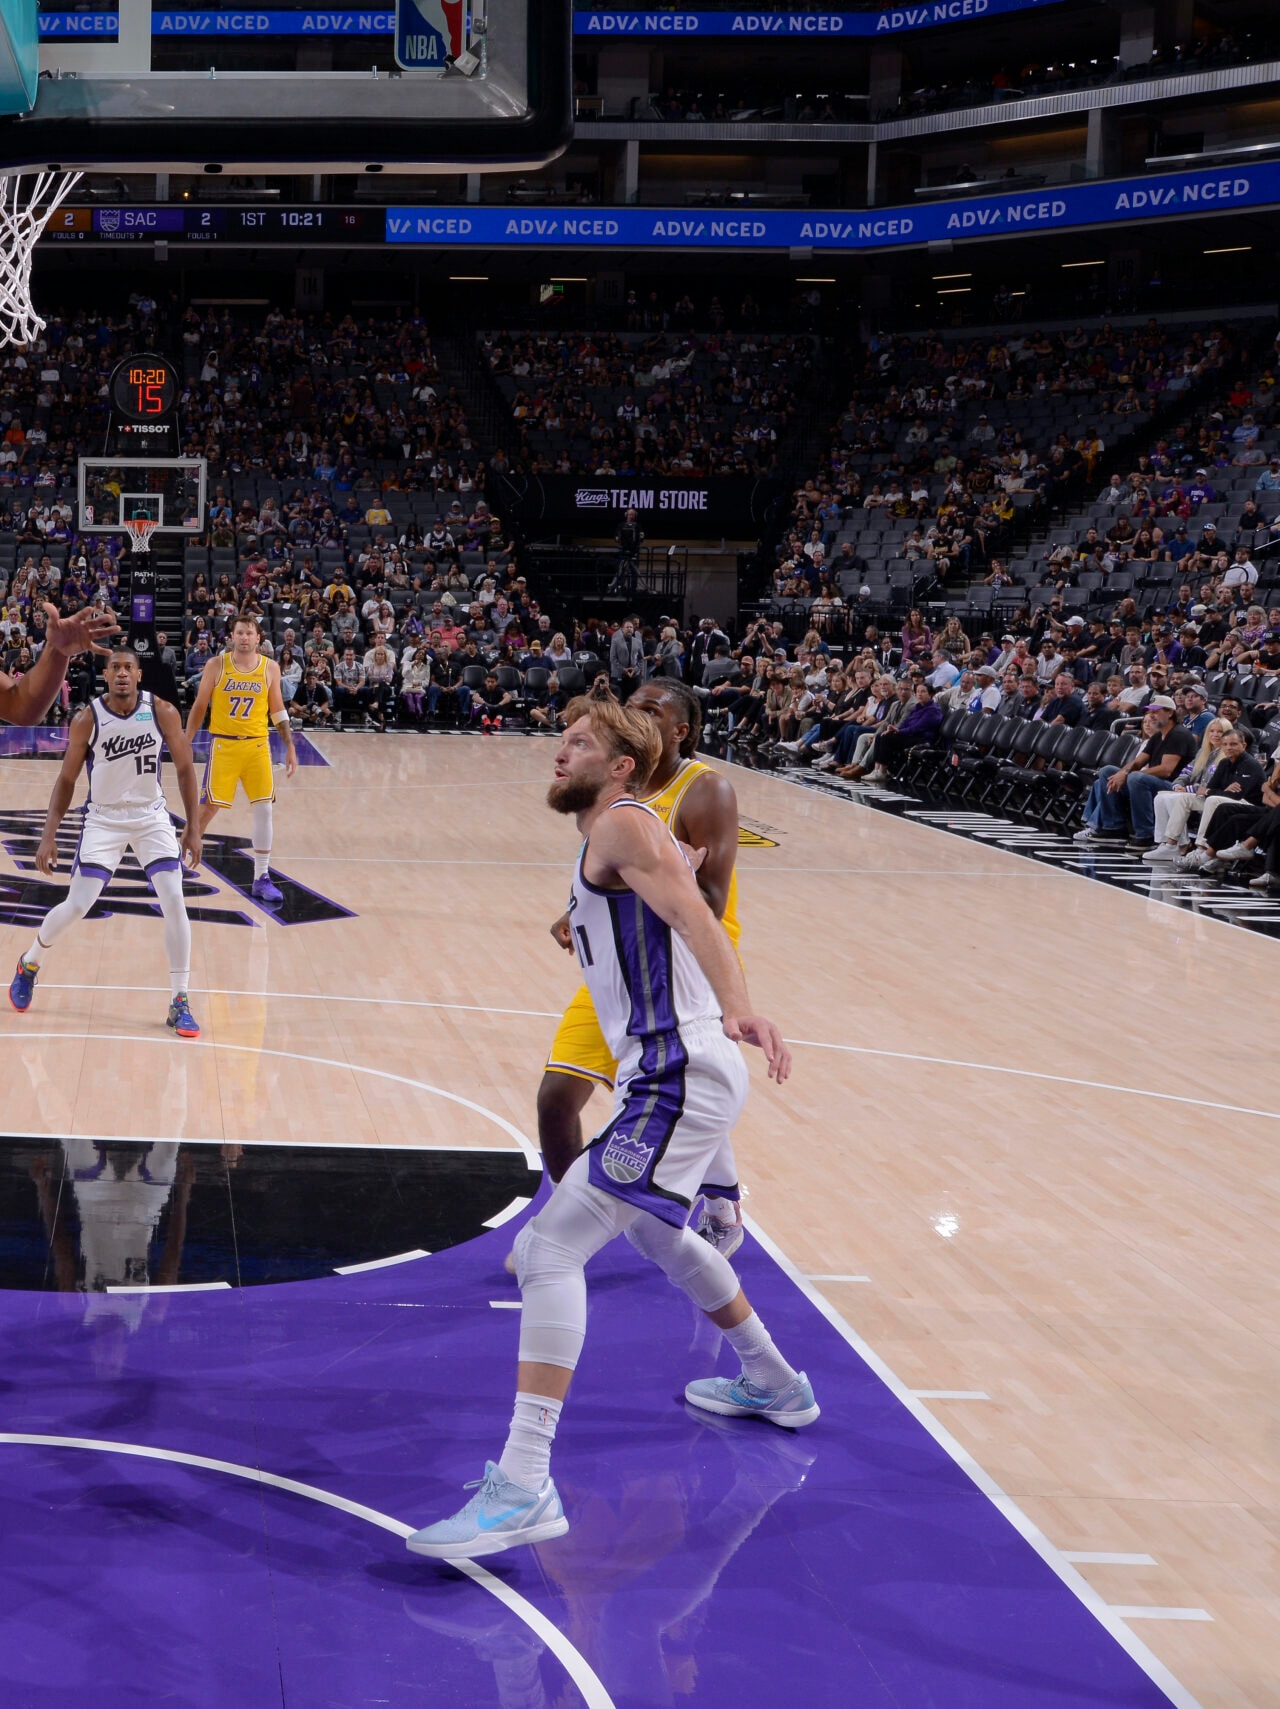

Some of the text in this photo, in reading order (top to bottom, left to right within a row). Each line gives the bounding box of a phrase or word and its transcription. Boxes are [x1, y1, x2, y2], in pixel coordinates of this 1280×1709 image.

[160, 15, 270, 31] ADVANCED
[302, 15, 397, 31] ADVANCE
[587, 15, 700, 31] ADVANCED
[732, 15, 844, 32] ADVANCED
[876, 0, 989, 31] ADVANCED
[405, 34, 439, 60] NBA
[1115, 178, 1250, 210] ADVANCED
[63, 212, 75, 227] 2
[124, 211, 356, 227] SAC 2 1ST 10:21 16
[947, 200, 1067, 230] ADVANCED
[505, 219, 619, 236] ADVANCED
[652, 221, 766, 238] ADVANCED
[800, 219, 914, 239] ADVANCED
[129, 369, 166, 384] 10:20
[137, 385, 163, 412] 15
[574, 489, 708, 510] Kings TEAM STORE
[222, 678, 262, 694] LAKERS
[228, 695, 255, 719] 77
[101, 732, 156, 762] Kings
[134, 754, 157, 776] 15
[604, 1148, 646, 1173] KINGS
